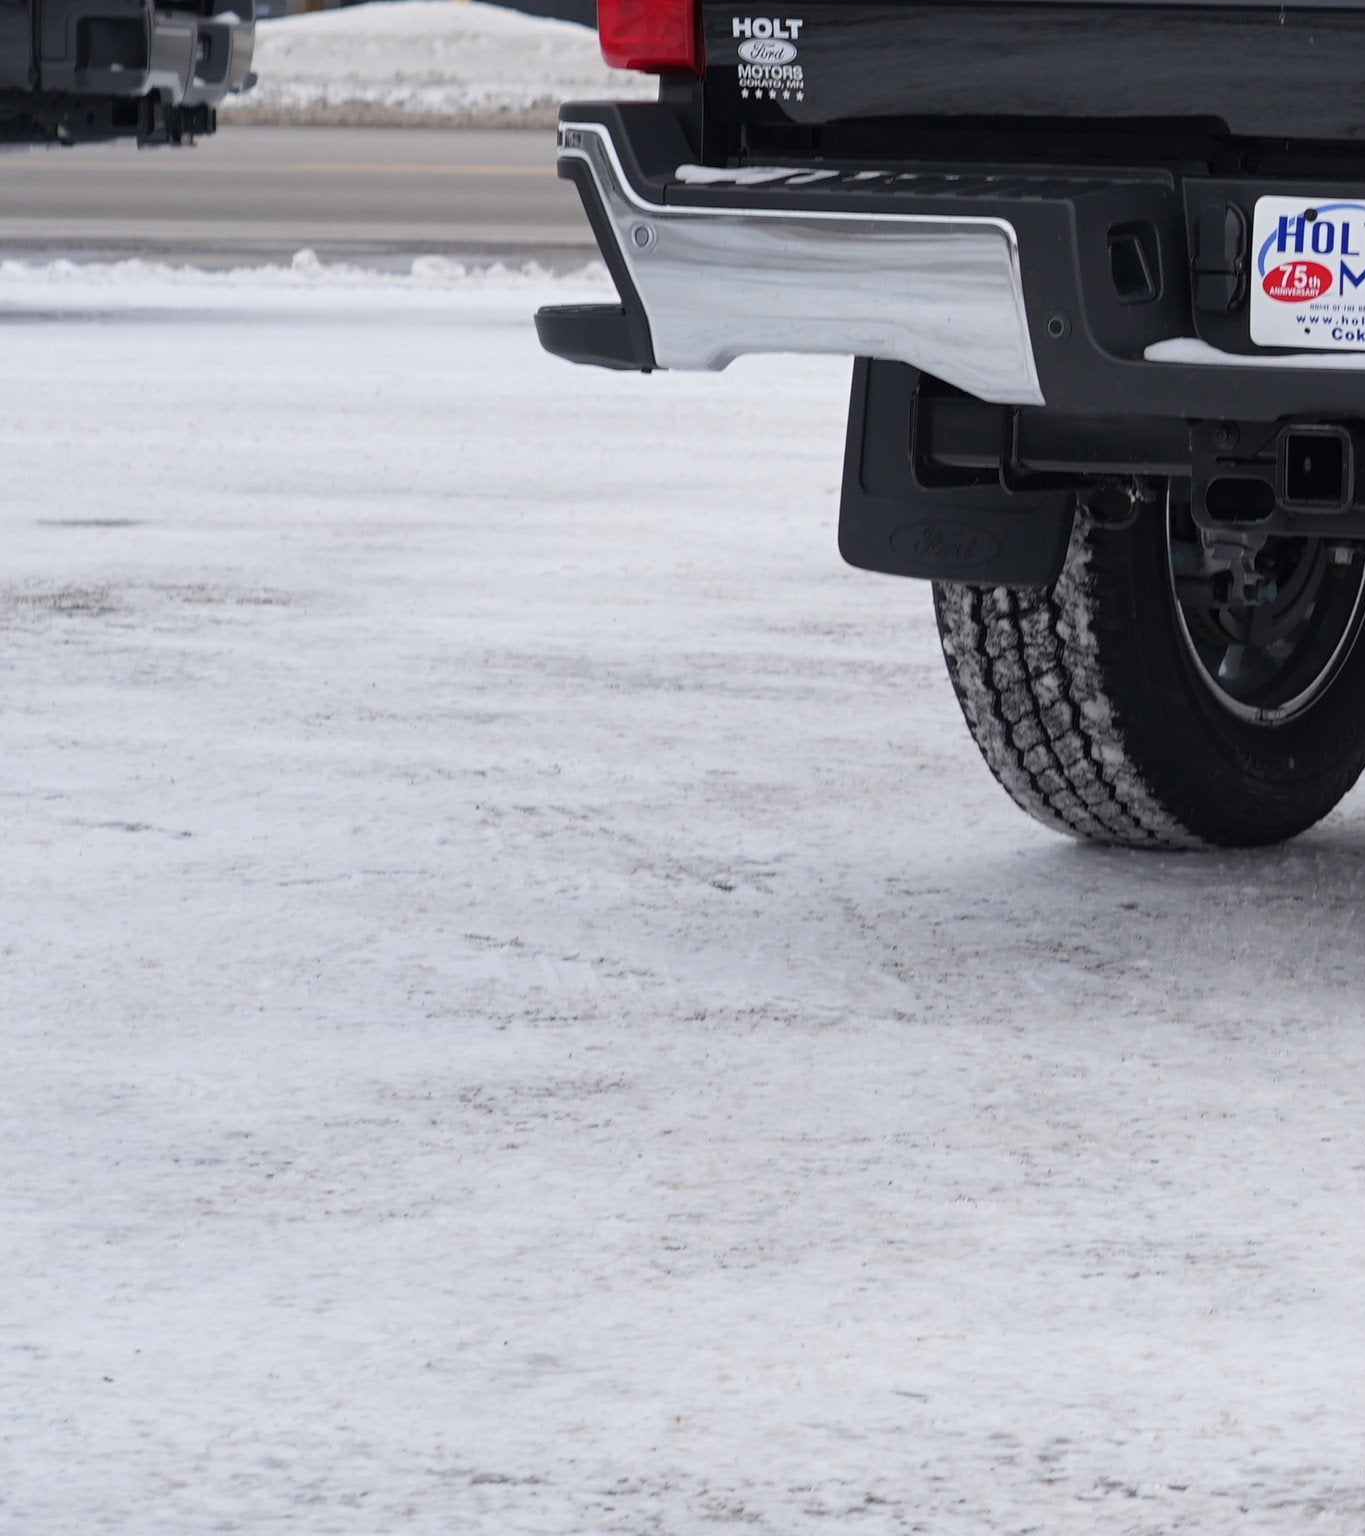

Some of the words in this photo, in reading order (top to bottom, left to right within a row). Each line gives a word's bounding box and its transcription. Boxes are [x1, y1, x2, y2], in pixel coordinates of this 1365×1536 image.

[732, 17, 803, 39] HOLT
[750, 41, 785, 60] Ford
[738, 64, 803, 80] MOTORS
[1279, 264, 1321, 289] 75th
[1269, 285, 1320, 297] ANNIVERSARY
